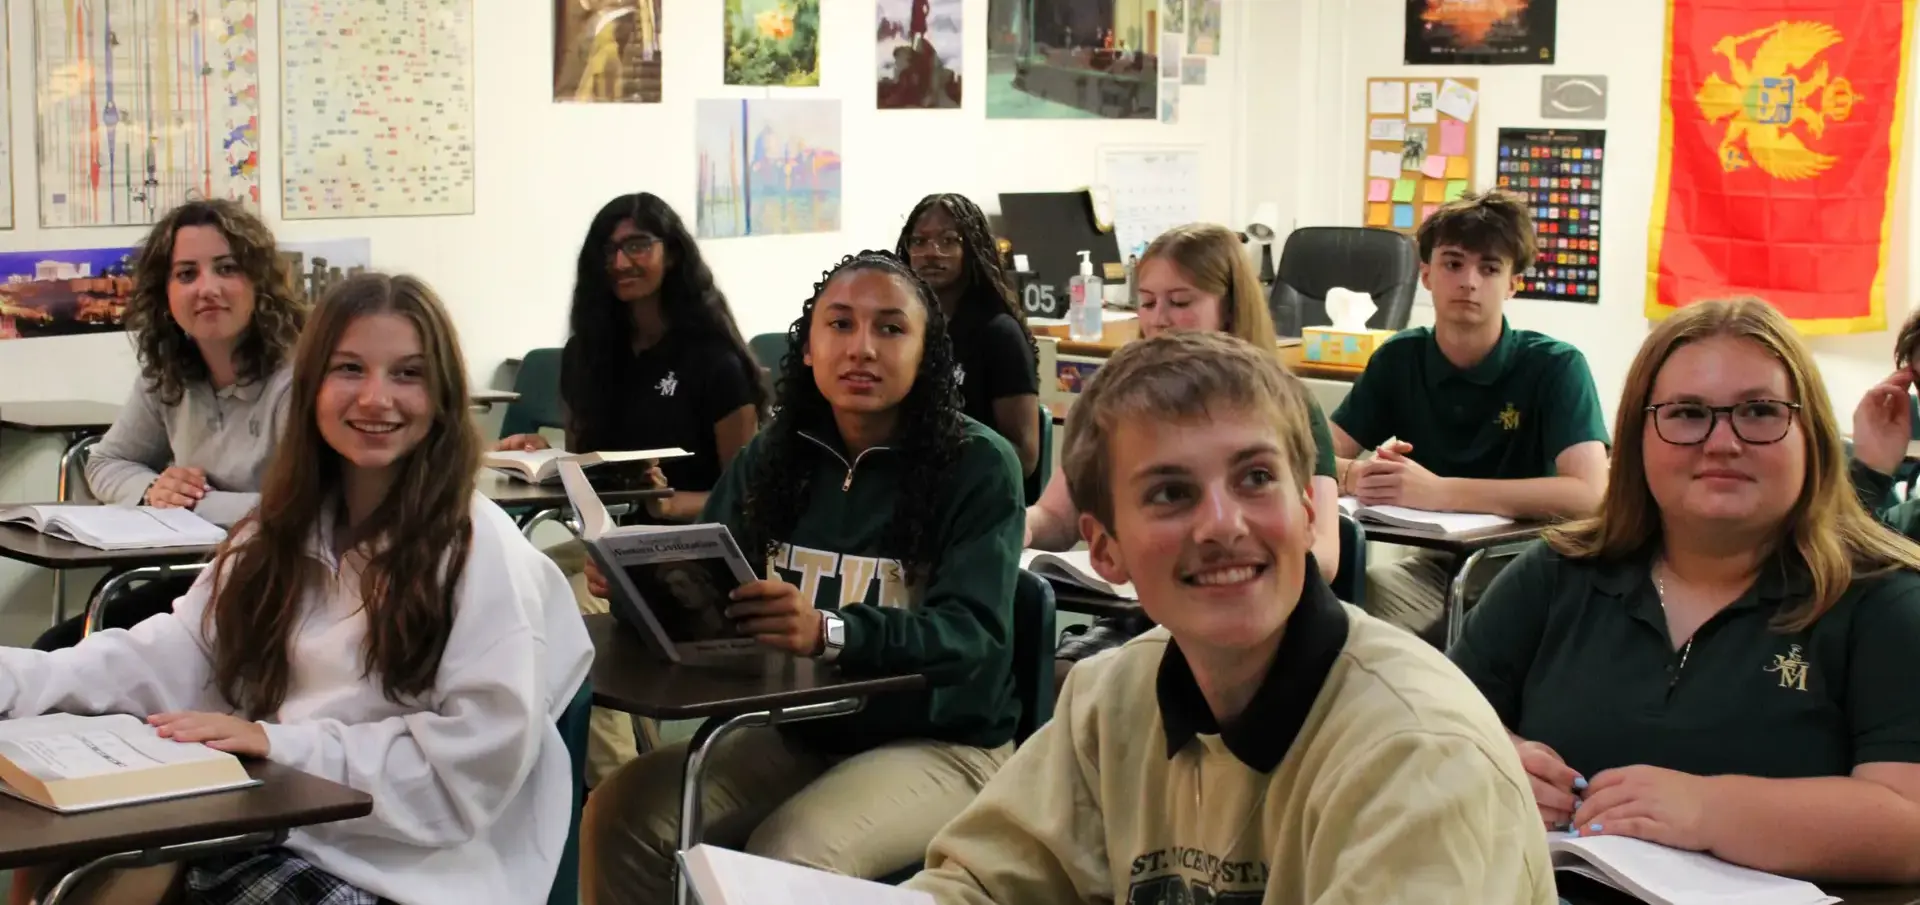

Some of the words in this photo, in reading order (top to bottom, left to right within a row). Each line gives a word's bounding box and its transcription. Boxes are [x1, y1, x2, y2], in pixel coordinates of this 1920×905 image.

[1024, 283, 1056, 313] 05
[1131, 849, 1168, 875] ST.
[1221, 861, 1259, 883] ST.
